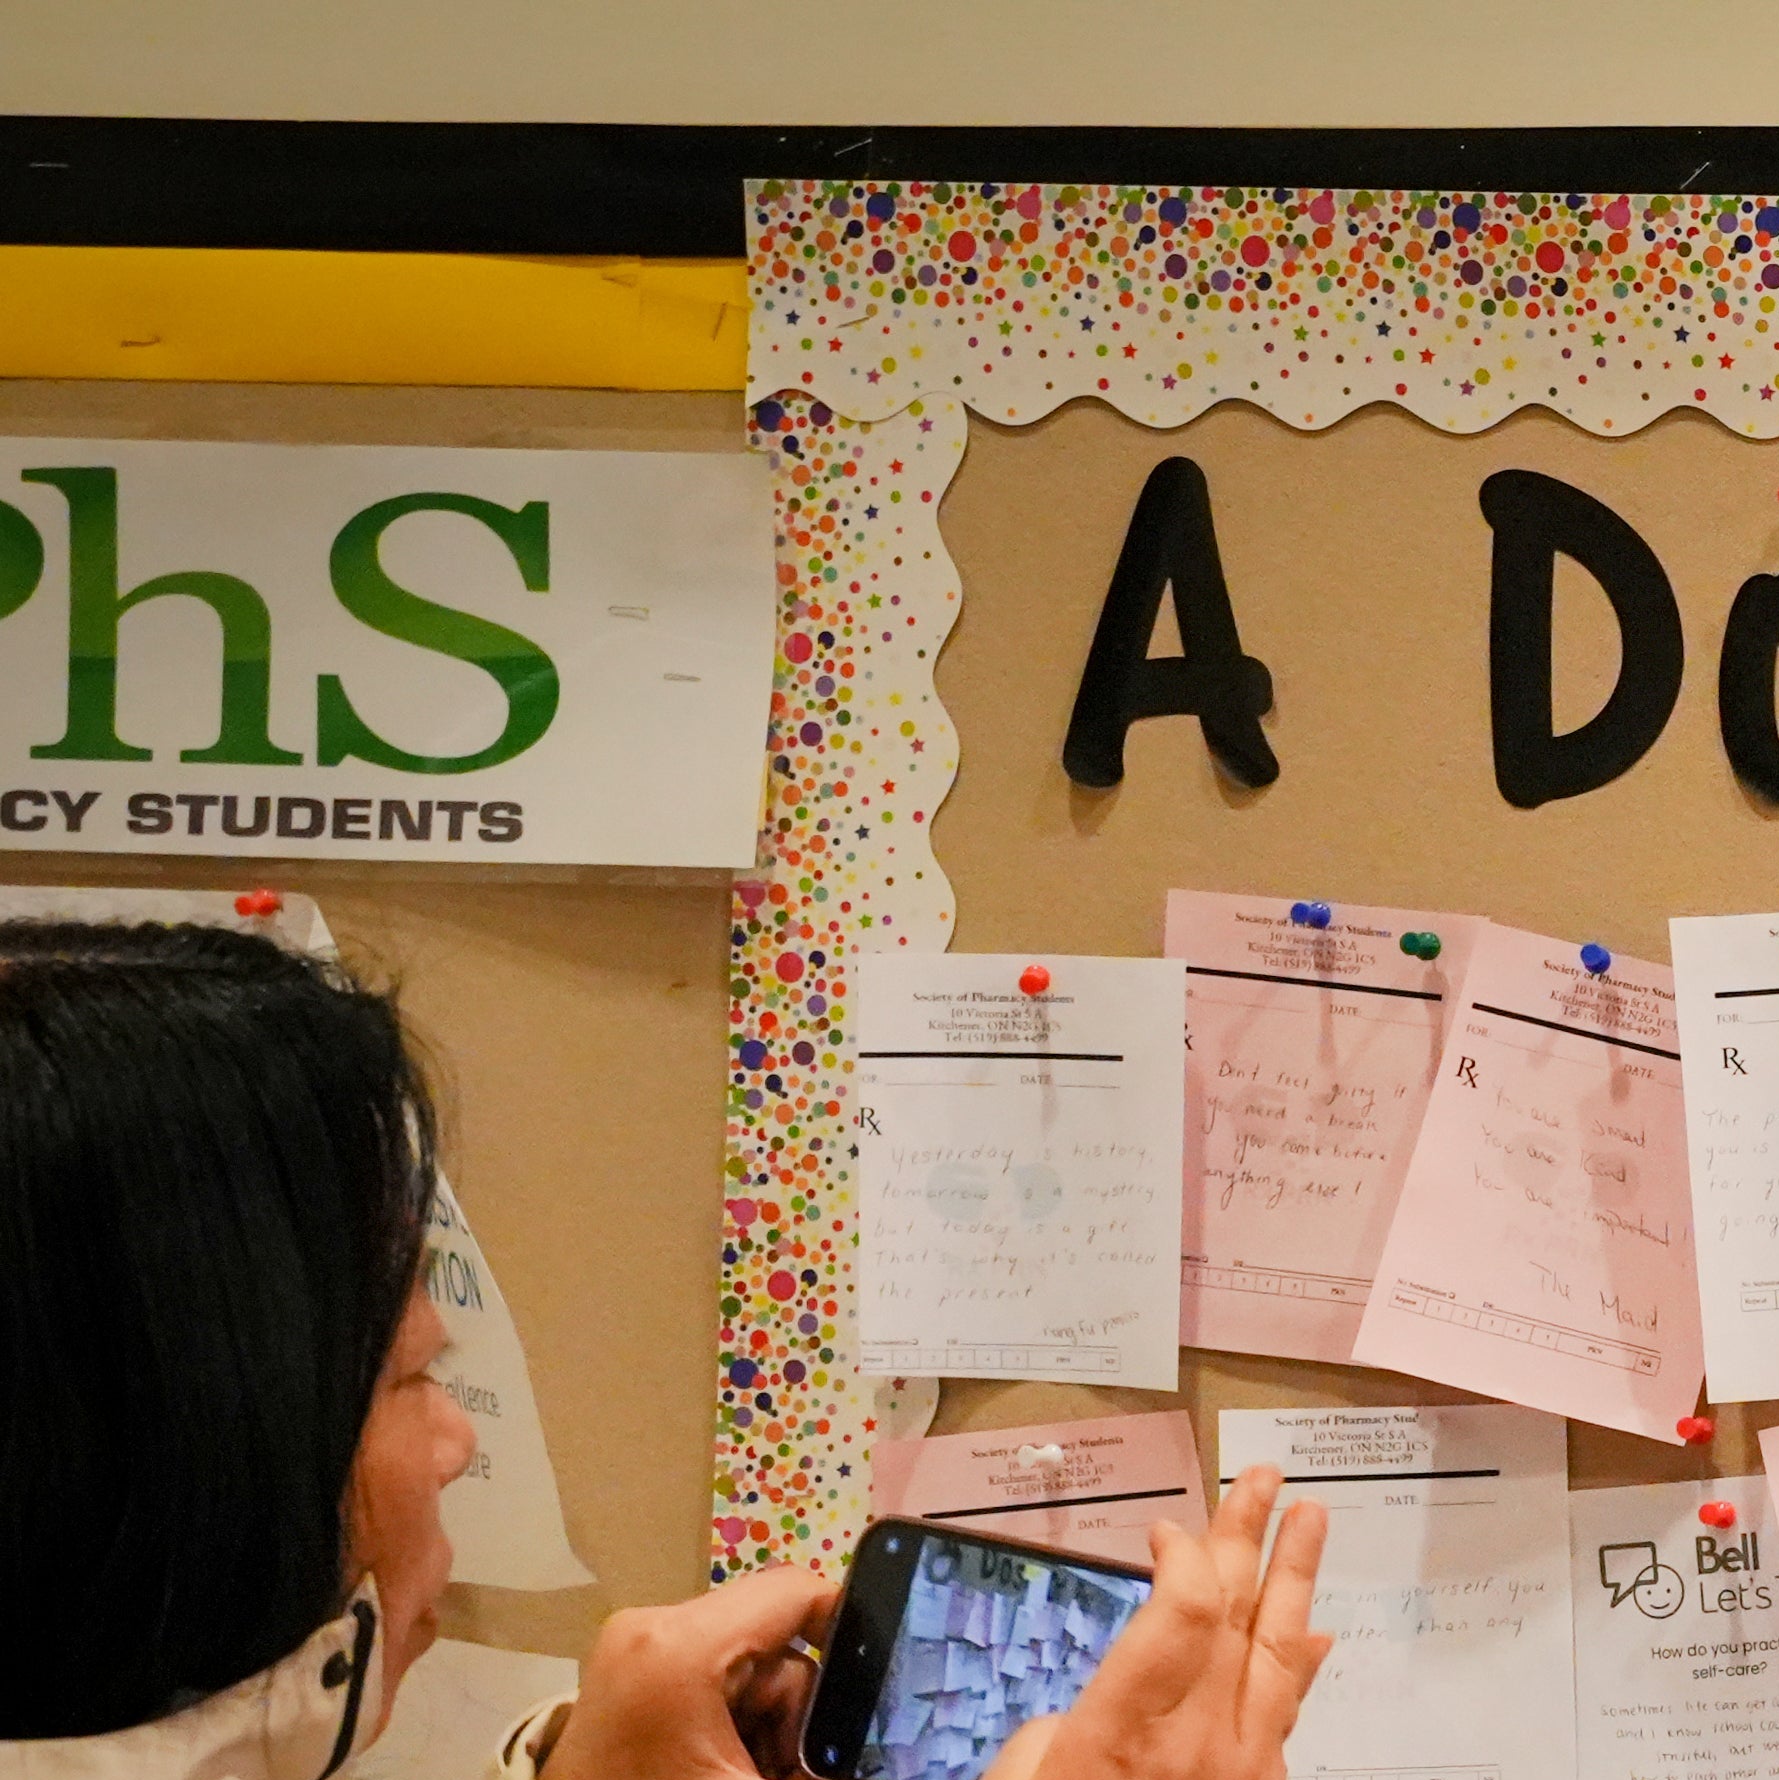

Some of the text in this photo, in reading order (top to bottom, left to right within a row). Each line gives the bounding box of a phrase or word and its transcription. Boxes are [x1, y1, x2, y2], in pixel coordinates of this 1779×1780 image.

[1062, 455, 1280, 788] A
[126, 793, 525, 844] STUDENTS
[1695, 1532, 1760, 1575] Bell
[1700, 1578, 1772, 1614] Let's
[1651, 1646, 1683, 1660] How
[1687, 1643, 1707, 1657] do
[1711, 1642, 1739, 1659] you
[1692, 1661, 1768, 1680] self-care?
